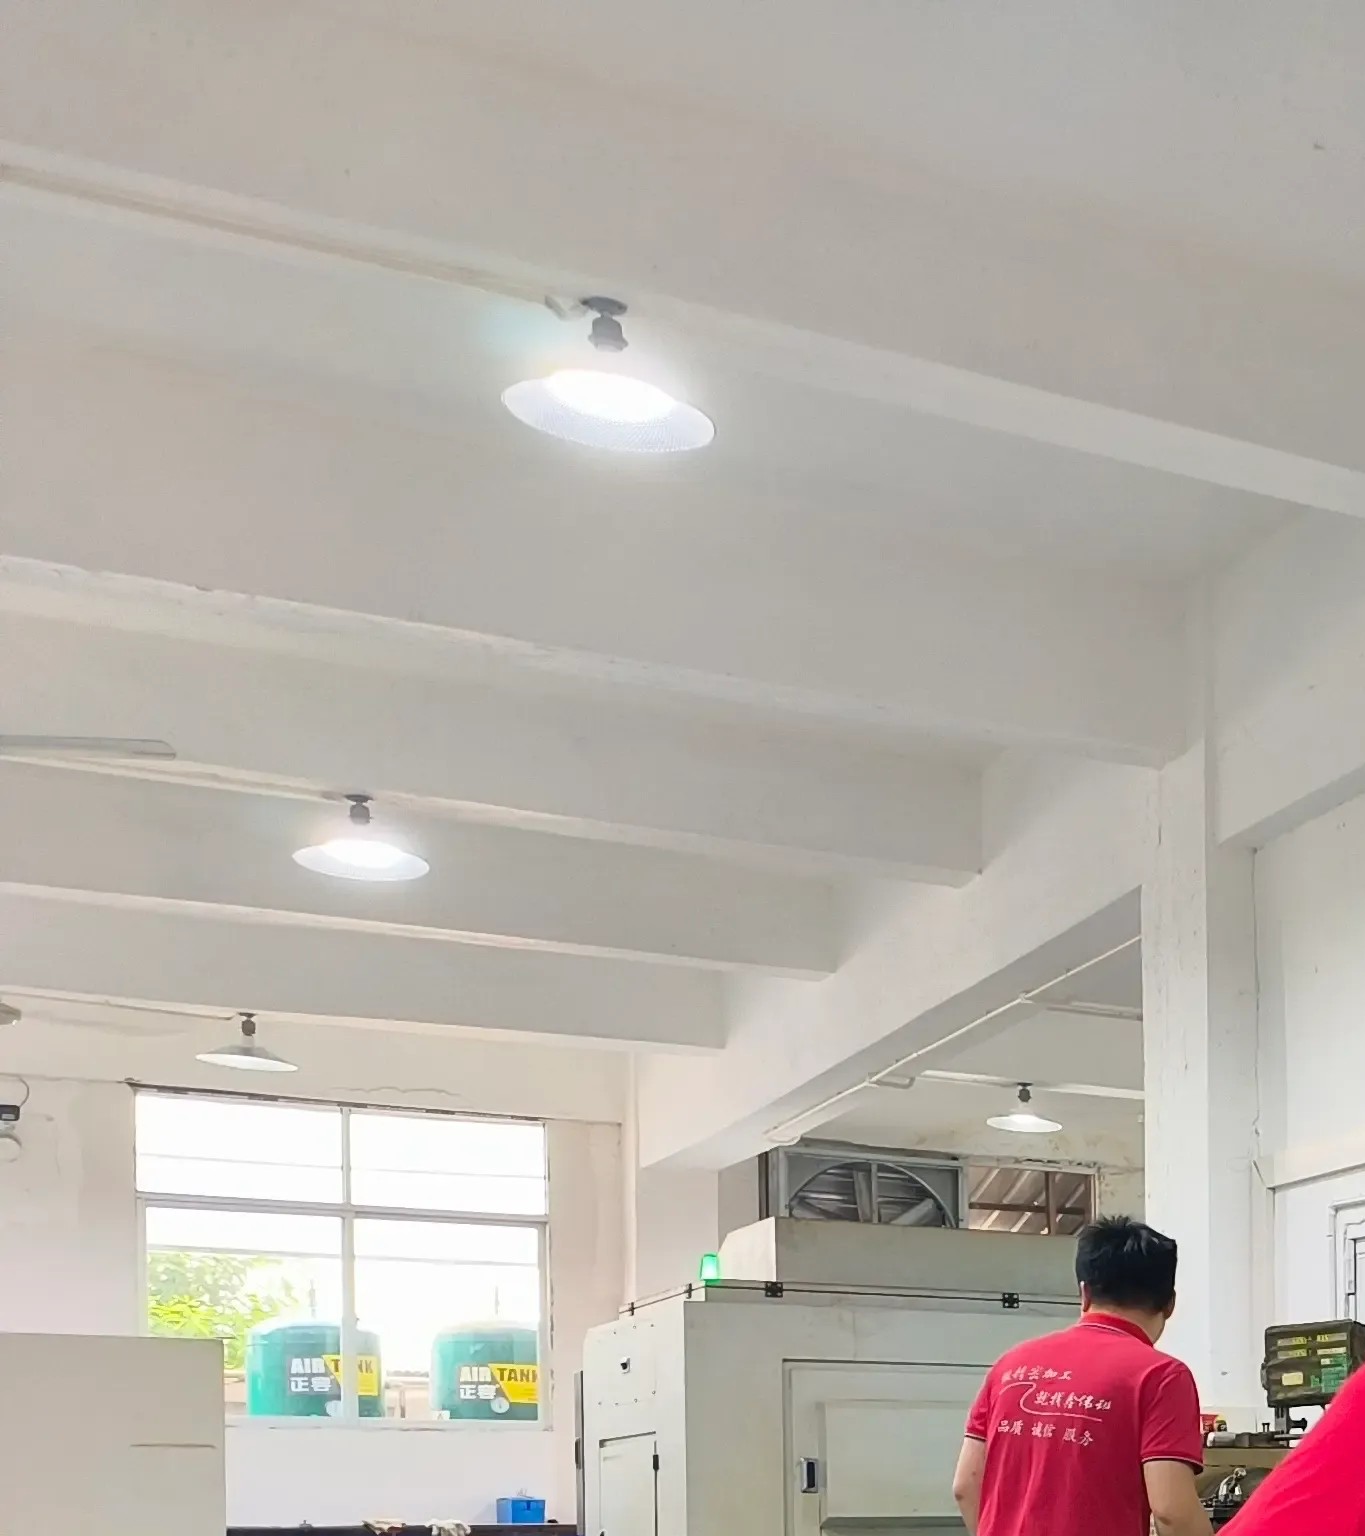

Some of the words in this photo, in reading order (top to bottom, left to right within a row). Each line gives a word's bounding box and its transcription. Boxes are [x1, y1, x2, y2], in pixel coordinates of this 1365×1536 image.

[290, 1357, 326, 1374] AIR
[331, 1359, 374, 1374] TNK
[459, 1366, 492, 1382] AIR
[998, 1420, 1023, 1436] 品质
[1063, 1428, 1094, 1446] 服务
